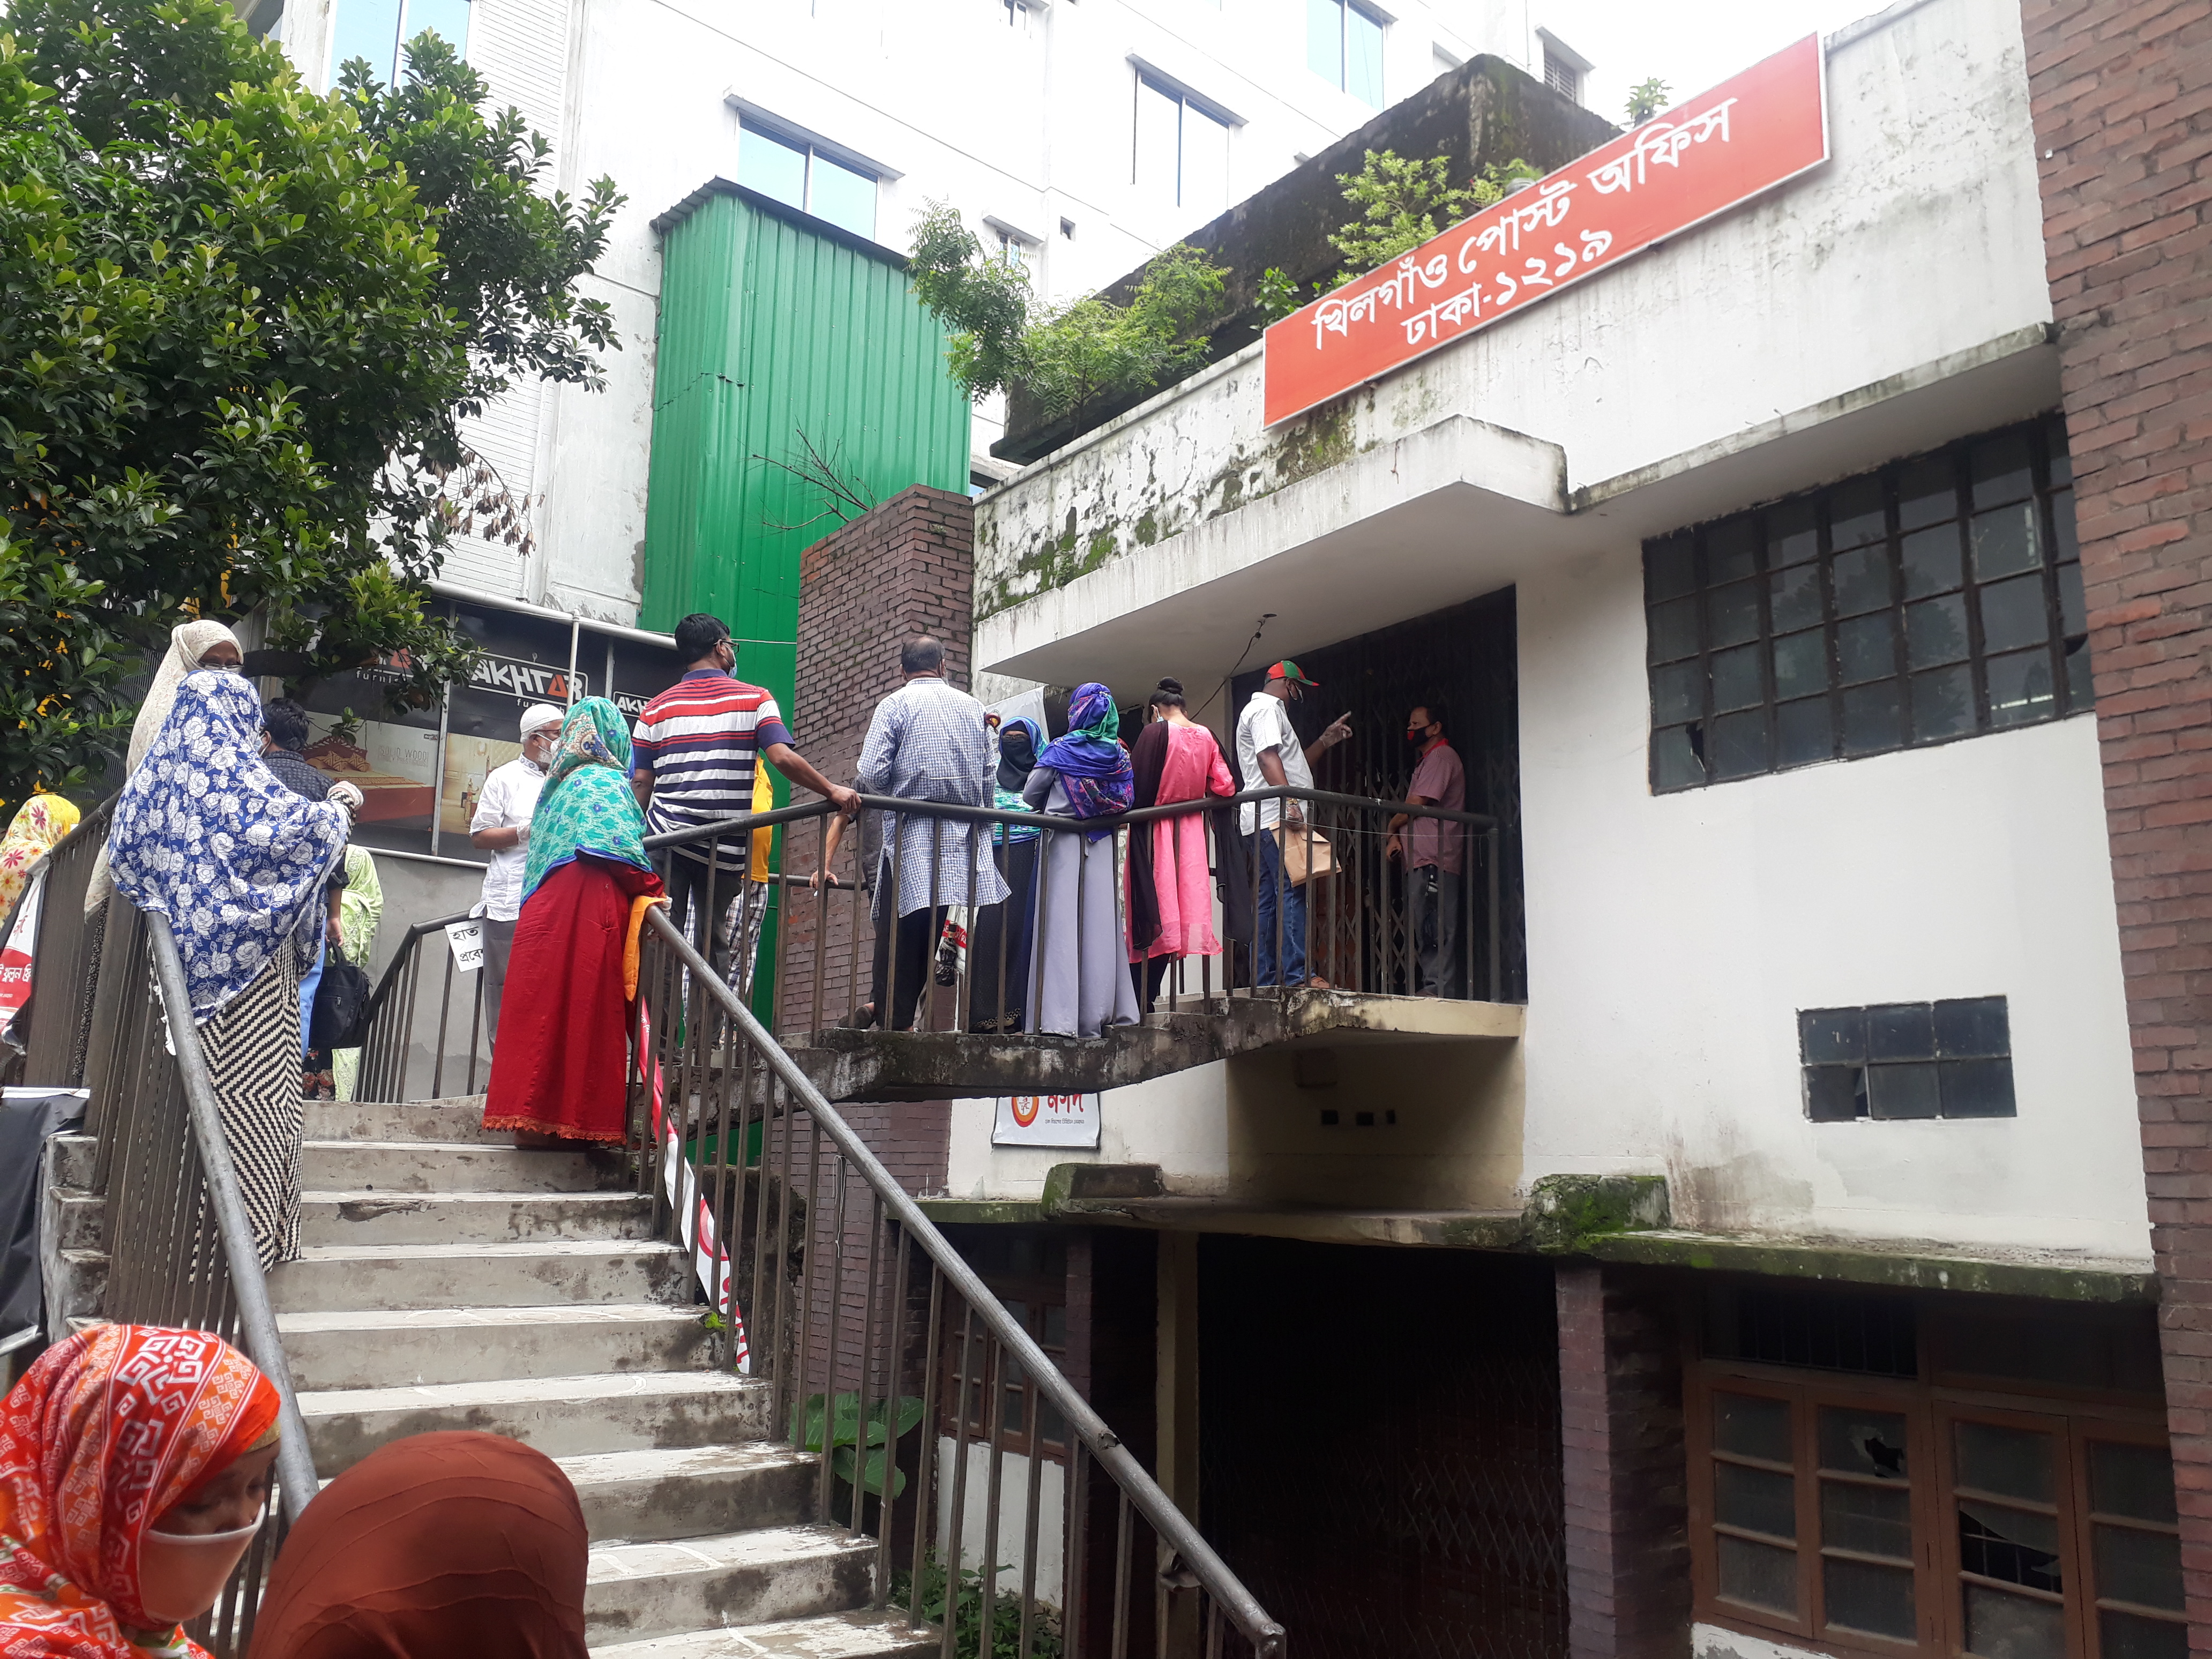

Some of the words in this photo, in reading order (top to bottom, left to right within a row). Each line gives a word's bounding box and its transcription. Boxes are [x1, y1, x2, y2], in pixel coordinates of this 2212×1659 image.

[1311, 255, 1448, 350] খিলগাঁও
[1458, 180, 1578, 274] পোস্ট
[1586, 97, 1739, 194] অফিস
[1400, 229, 1613, 345] ঢাকা-১২১৯
[470, 659, 583, 701] AKHTAR
[449, 926, 479, 941] হাত
[459, 948, 483, 963] প্রবে
